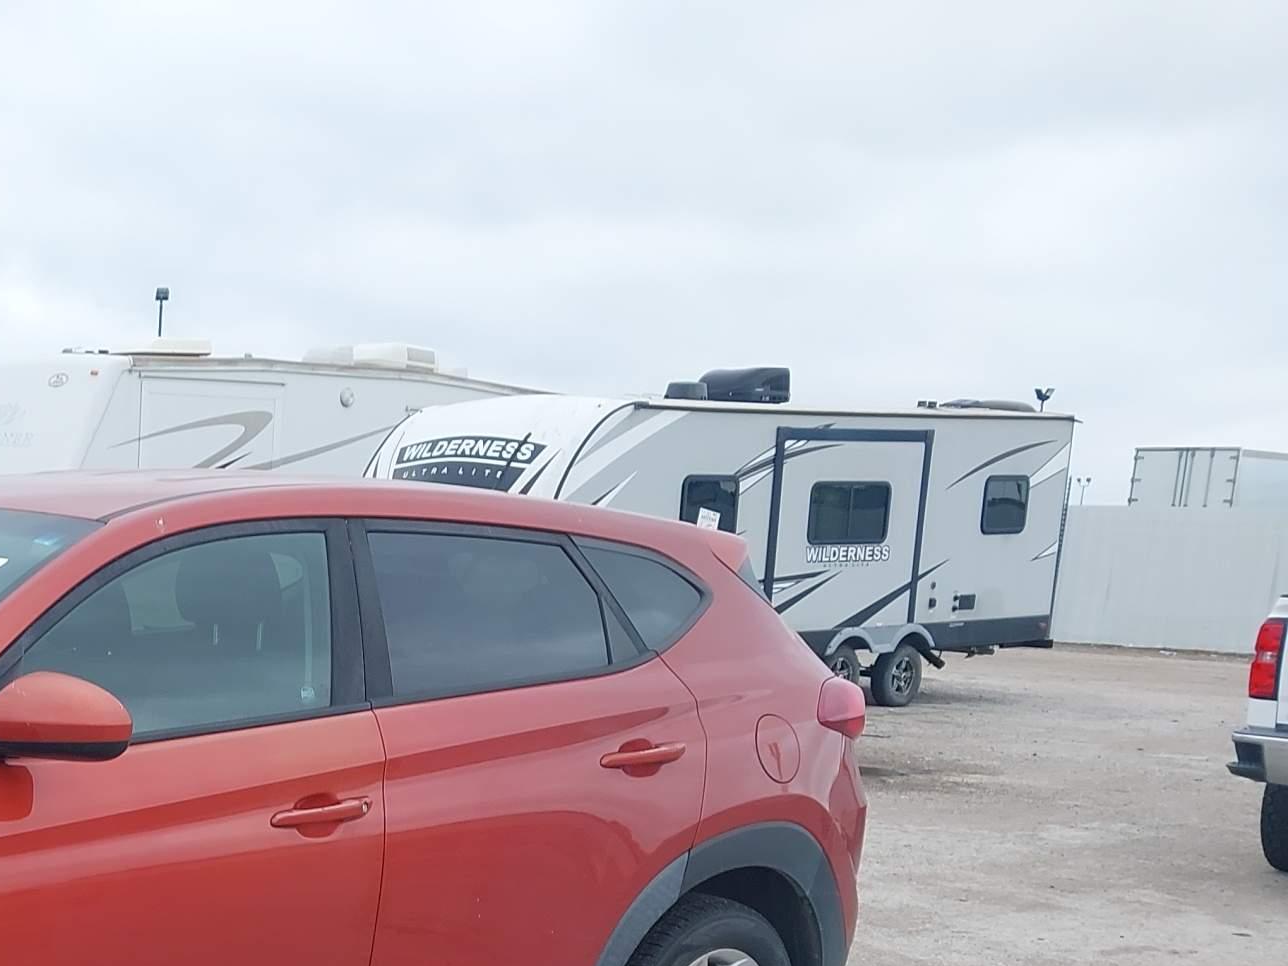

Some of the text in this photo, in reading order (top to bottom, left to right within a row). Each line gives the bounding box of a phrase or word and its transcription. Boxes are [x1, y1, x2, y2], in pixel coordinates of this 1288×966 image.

[402, 438, 535, 462] WILDERNESS
[402, 466, 504, 479] ULTRA LITE
[806, 545, 891, 562] WILDERNESS
